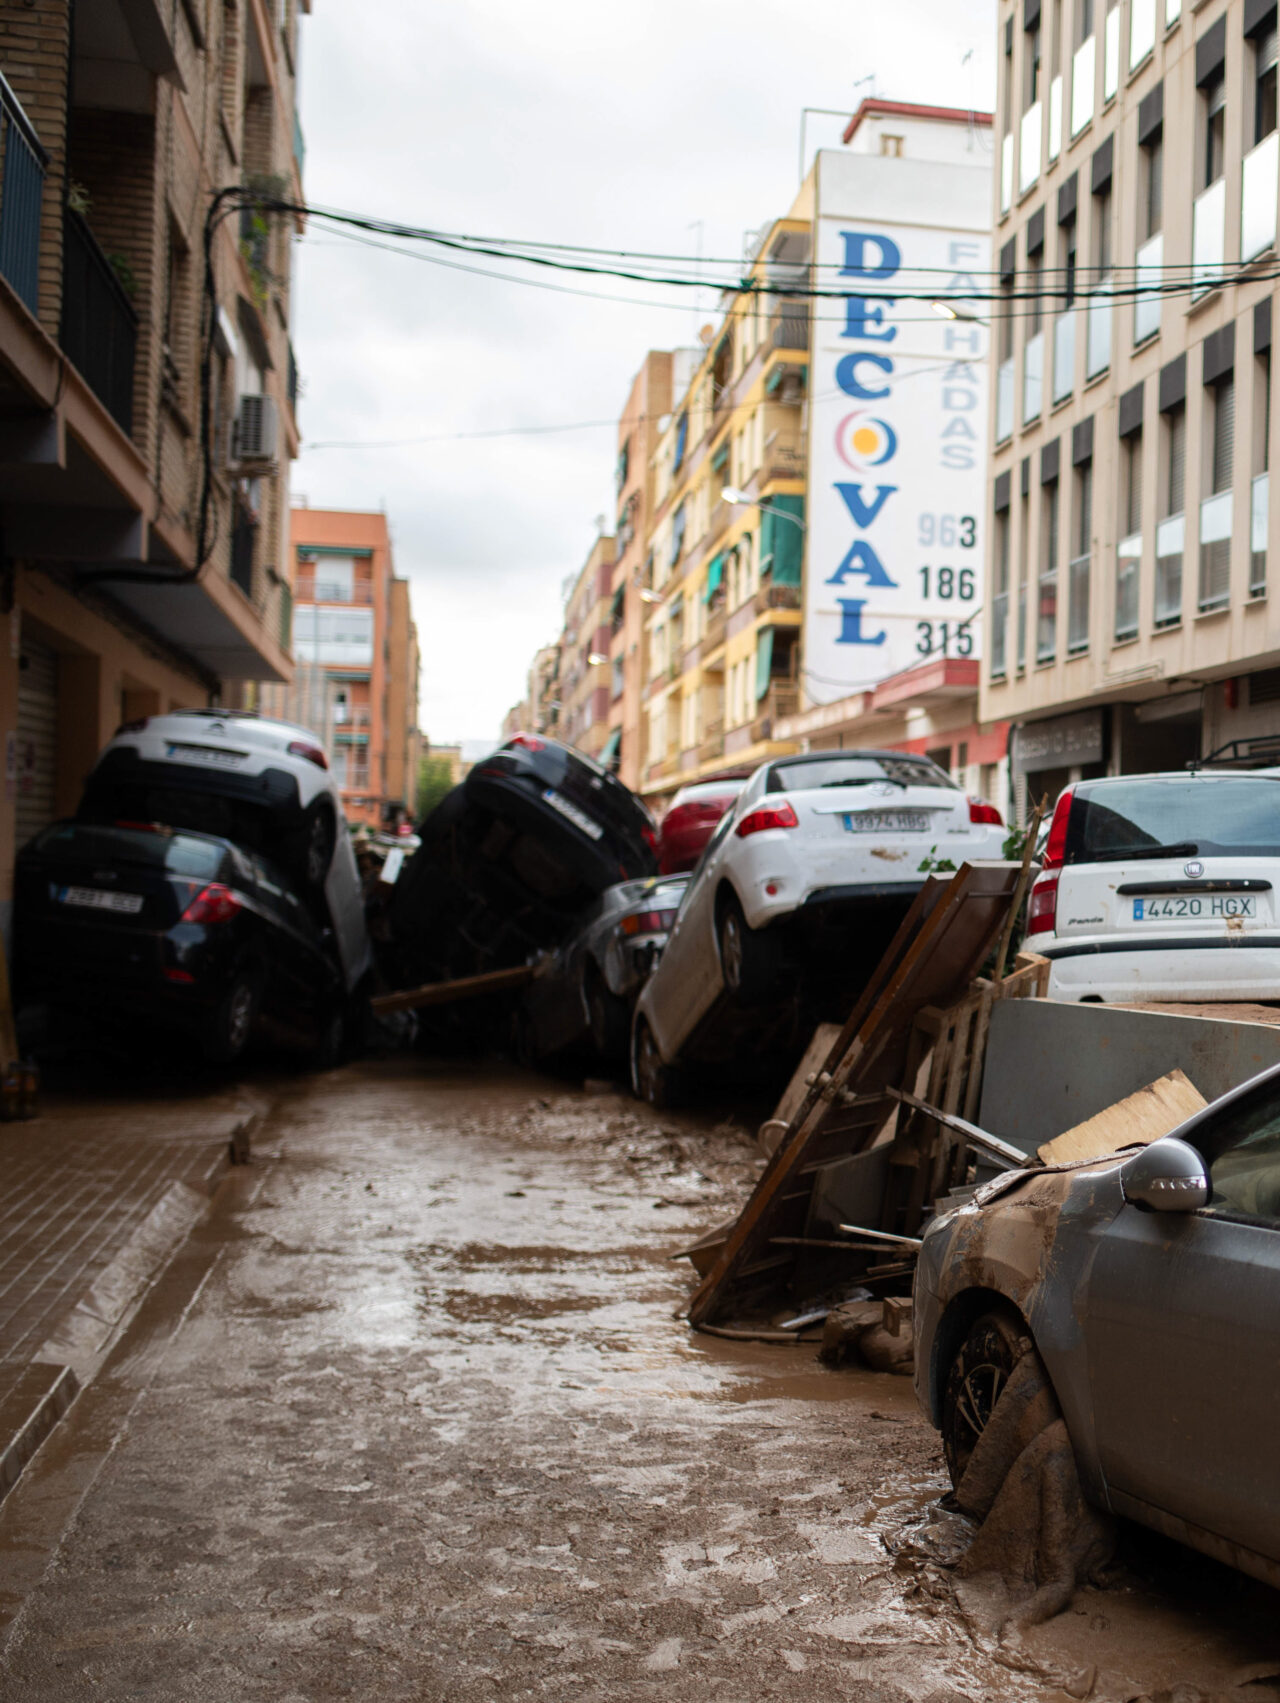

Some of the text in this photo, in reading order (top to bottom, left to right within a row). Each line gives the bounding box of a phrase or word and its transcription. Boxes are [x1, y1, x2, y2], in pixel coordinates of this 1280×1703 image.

[941, 241, 980, 471] FAHADAS
[918, 512, 977, 549] 963
[917, 565, 976, 601] 186
[915, 621, 974, 658] 315
[1147, 897, 1252, 918] 4420 HGX
